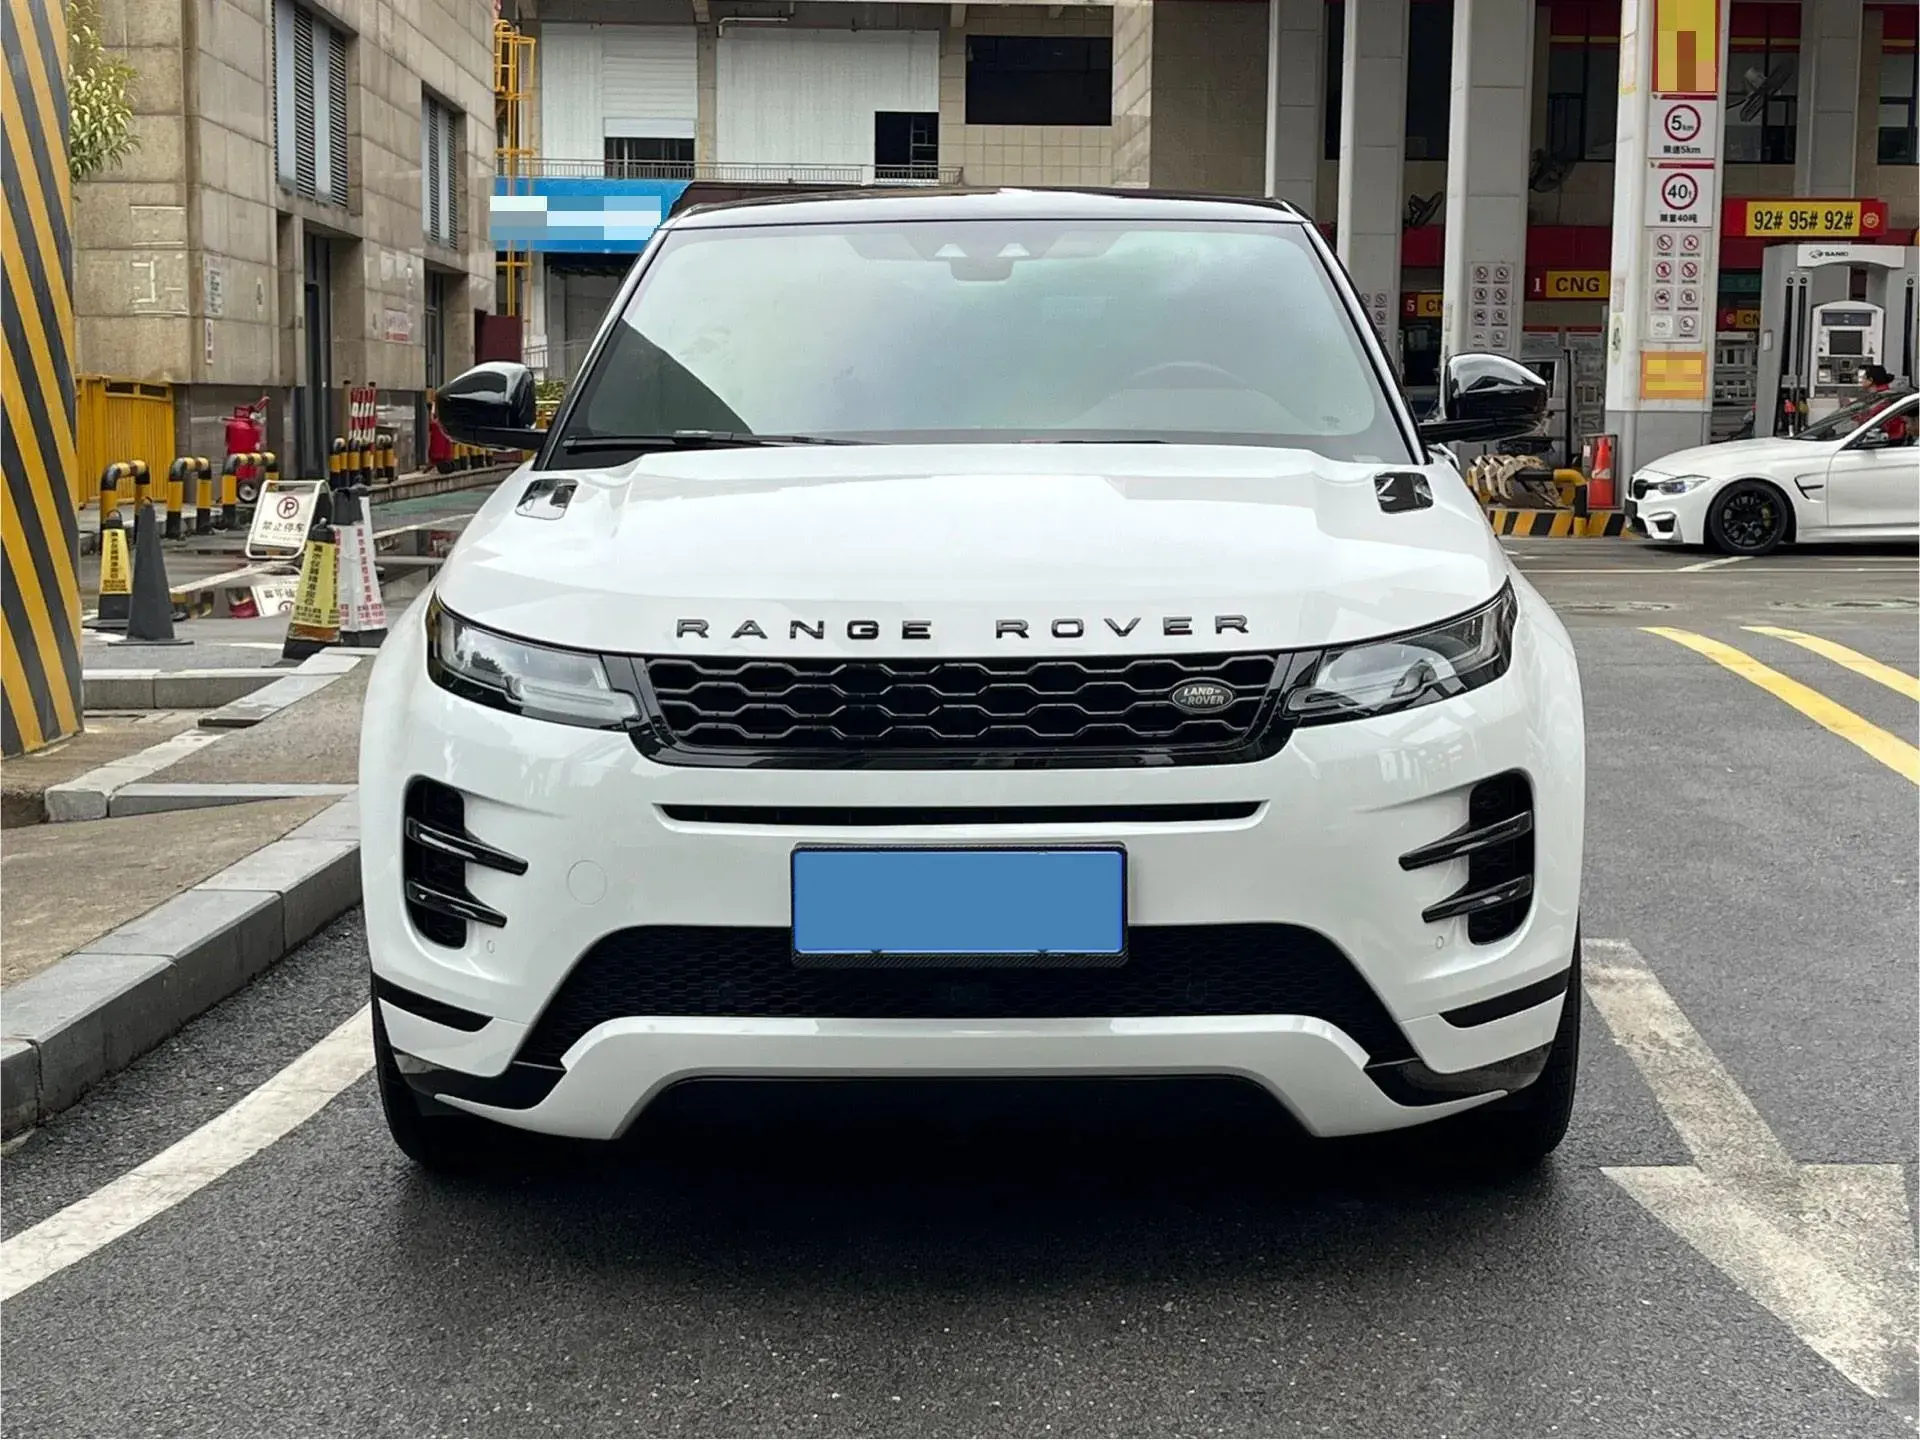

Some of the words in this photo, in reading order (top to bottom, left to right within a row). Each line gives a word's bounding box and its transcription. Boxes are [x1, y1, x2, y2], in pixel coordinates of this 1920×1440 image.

[1754, 210, 1783, 230] 92#
[1789, 210, 1818, 230] 95#
[1824, 210, 1853, 230] 92#
[1534, 277, 1541, 292] 1
[1555, 276, 1600, 293] CNG
[1406, 299, 1415, 312] 5
[262, 520, 305, 533] 禁止停车
[676, 618, 932, 641] RANGE
[996, 614, 1250, 639] ROVER
[1184, 687, 1214, 696] LAND
[1187, 695, 1224, 705] ROVER
